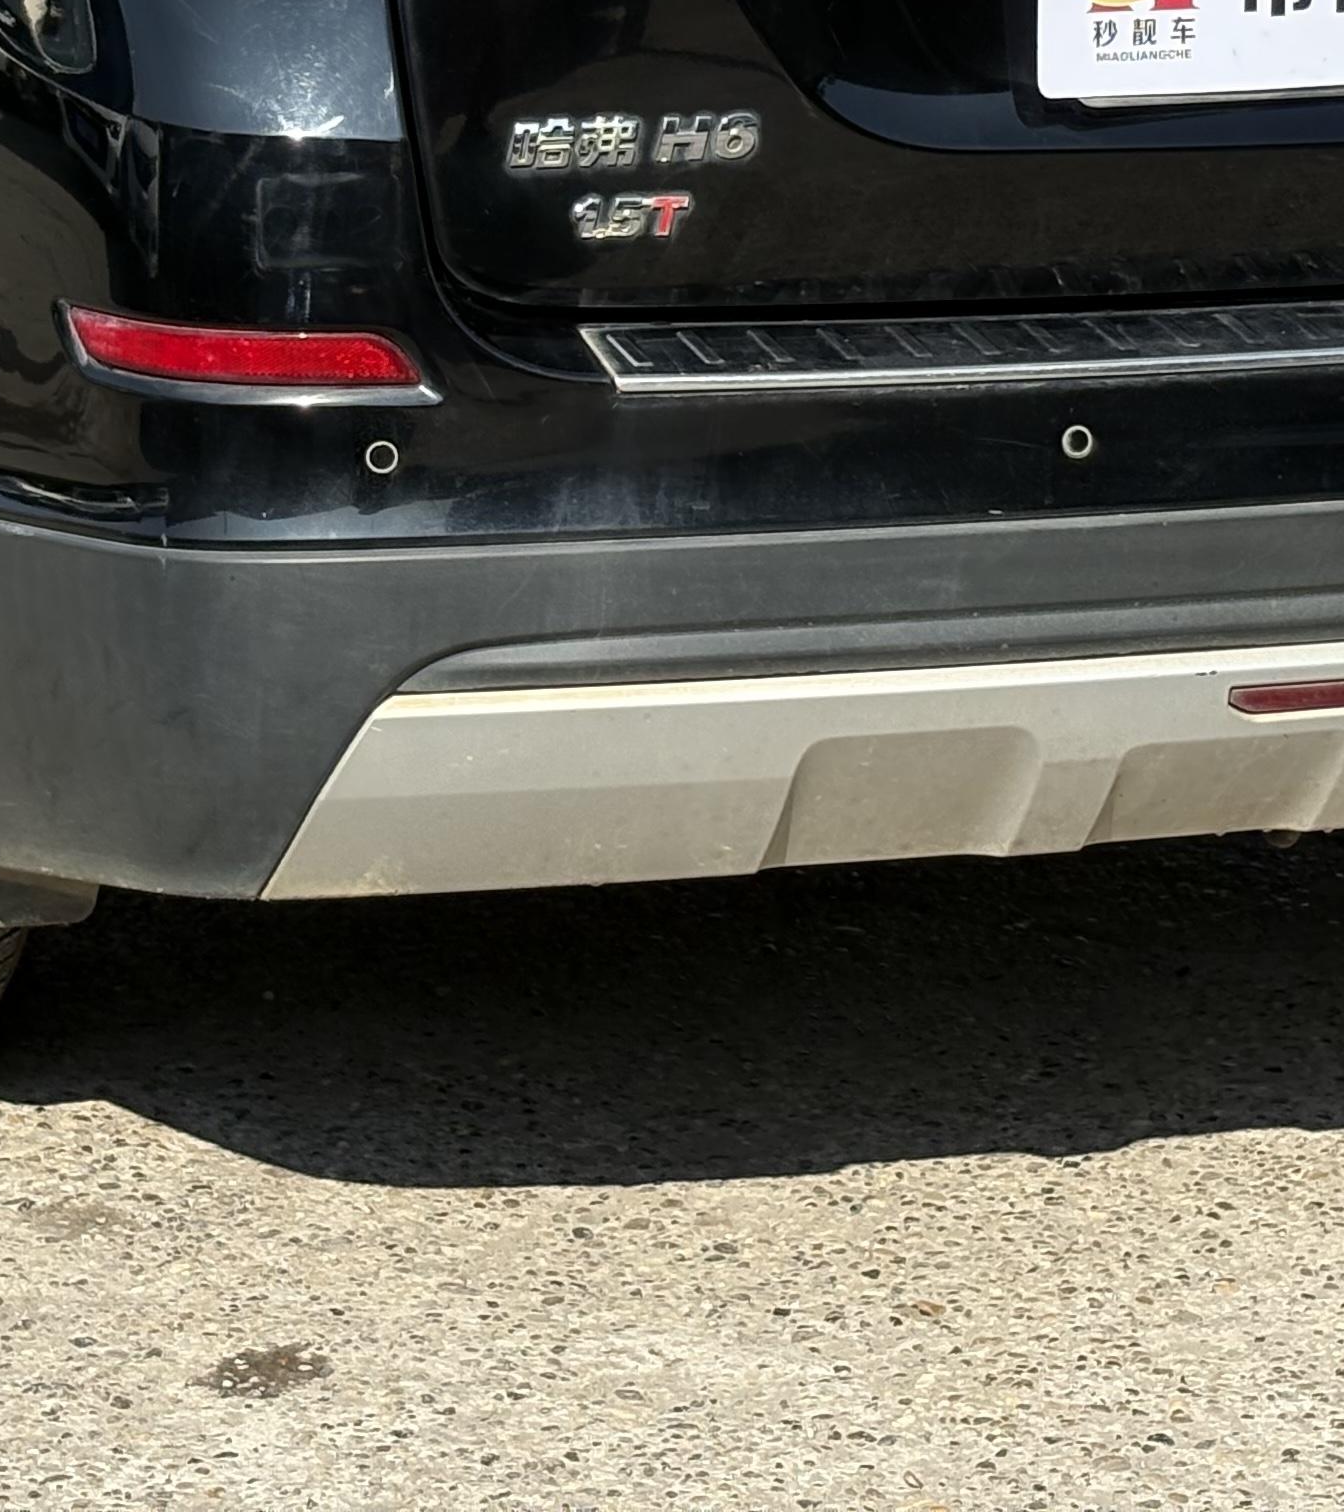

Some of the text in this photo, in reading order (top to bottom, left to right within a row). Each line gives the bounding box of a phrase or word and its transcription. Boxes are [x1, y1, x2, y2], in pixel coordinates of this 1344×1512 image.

[1092, 16, 1197, 48] 秒靓车
[508, 112, 759, 170] 哈弗 H6
